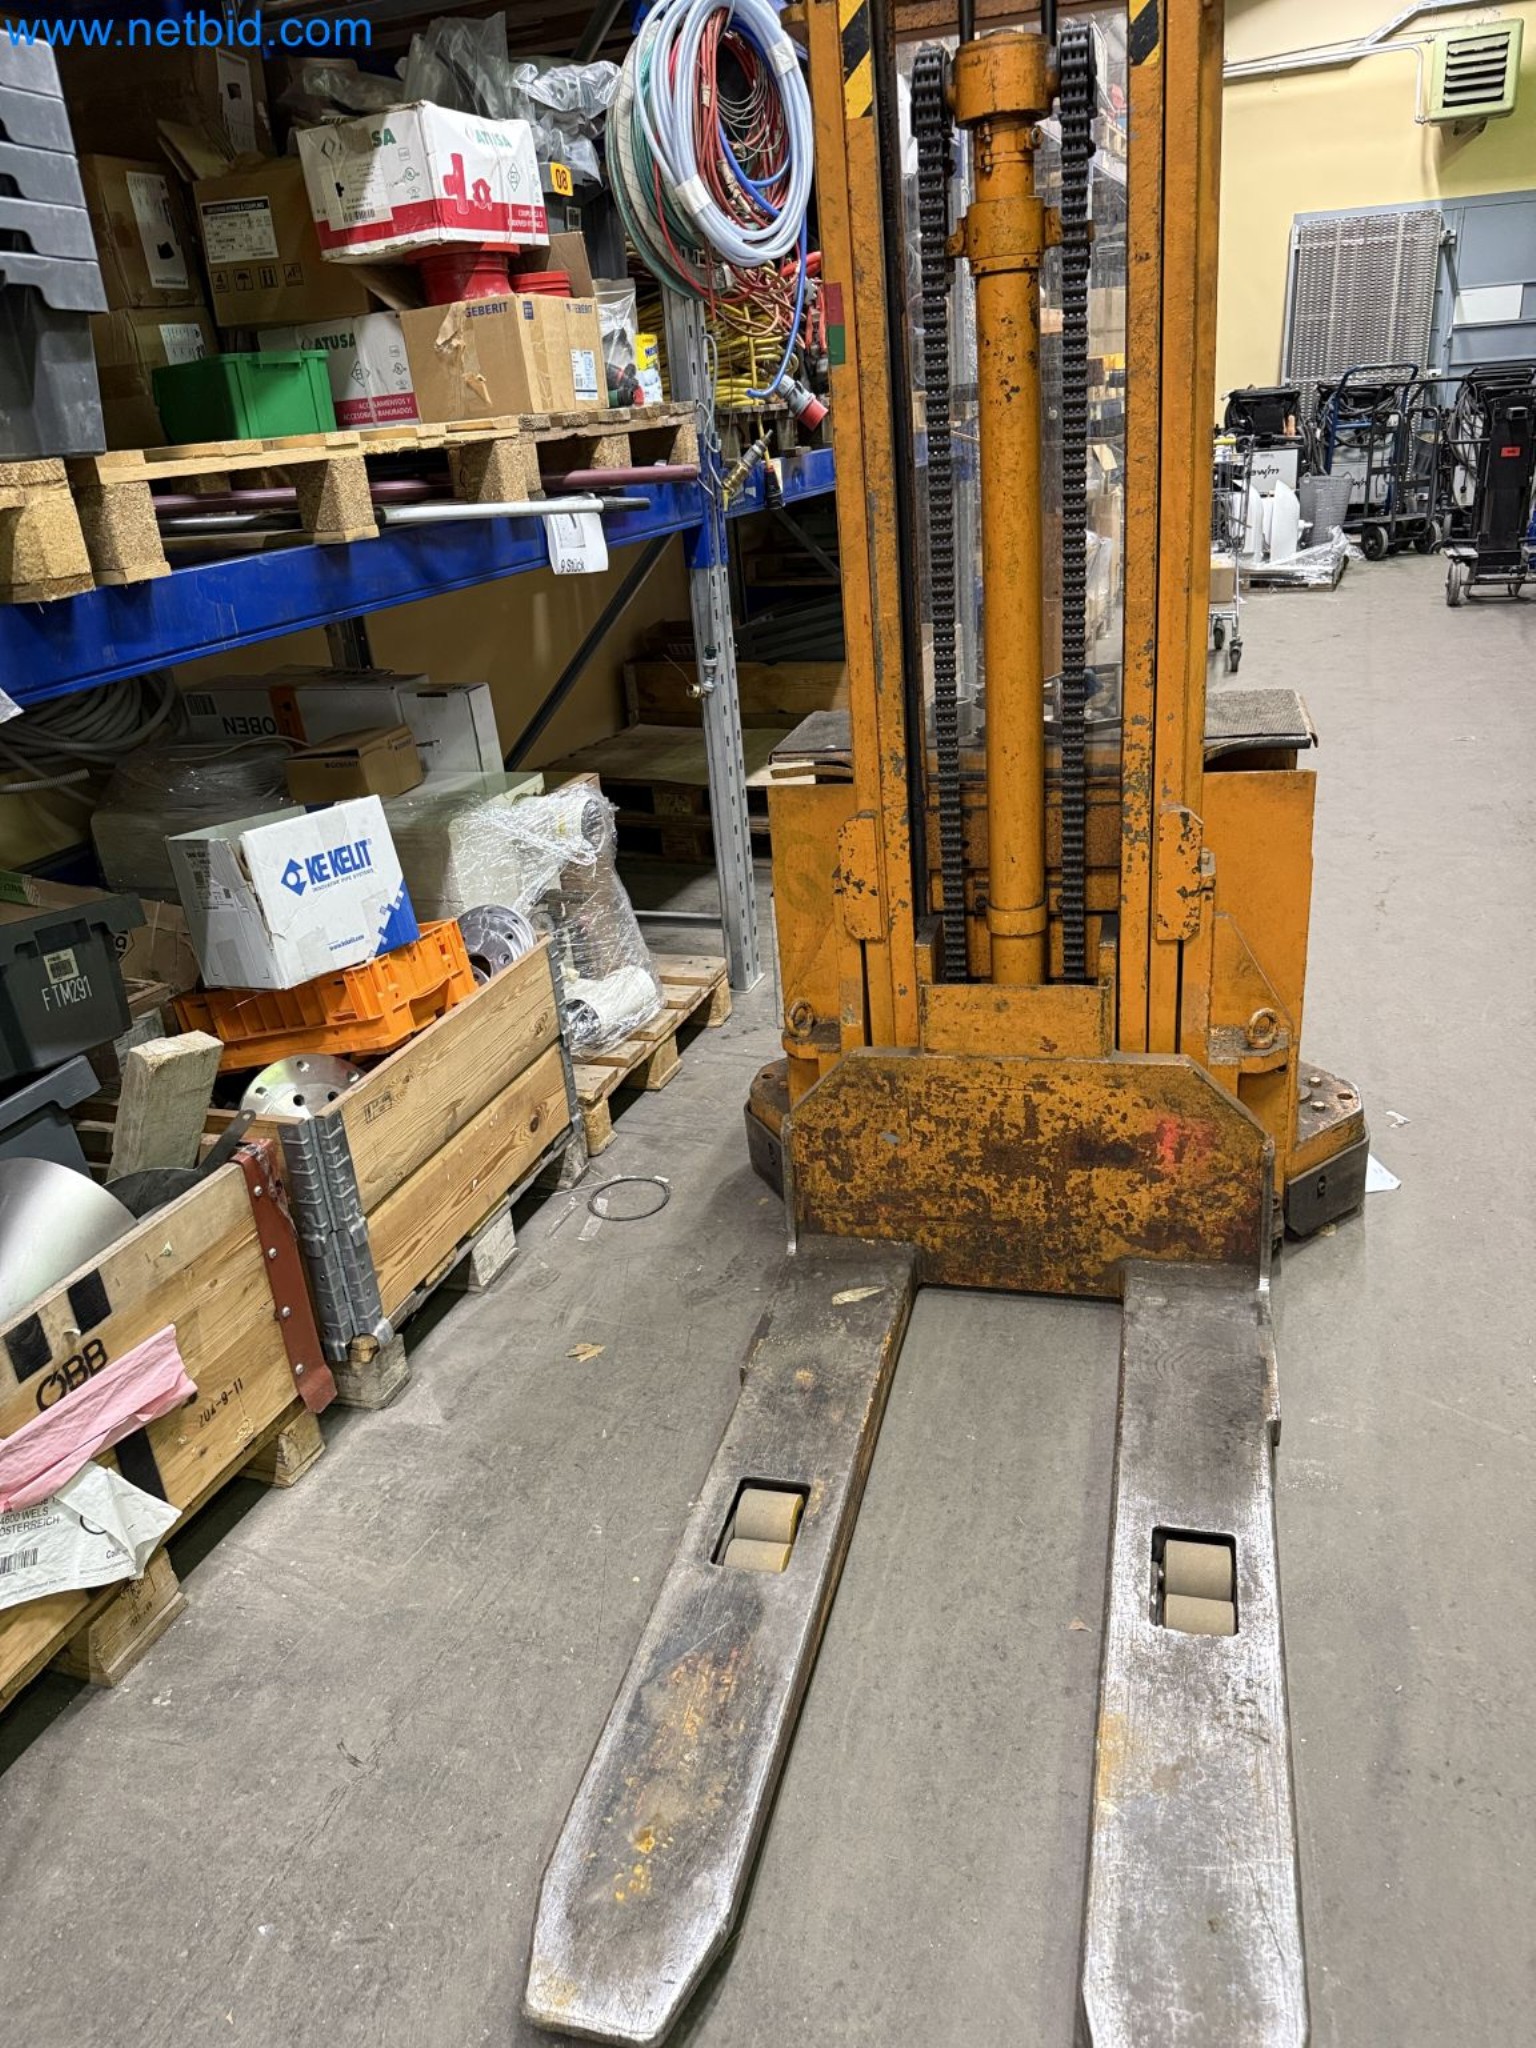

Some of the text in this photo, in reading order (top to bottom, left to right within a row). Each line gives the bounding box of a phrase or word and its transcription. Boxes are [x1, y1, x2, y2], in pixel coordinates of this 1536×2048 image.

[465, 302, 508, 317] GEBERIT
[314, 333, 356, 351] ATUSA
[222, 715, 277, 735] OBEN
[304, 839, 372, 886] KE KELIT
[41, 974, 94, 1012] FTM291
[21, 1505, 49, 1520] WELS
